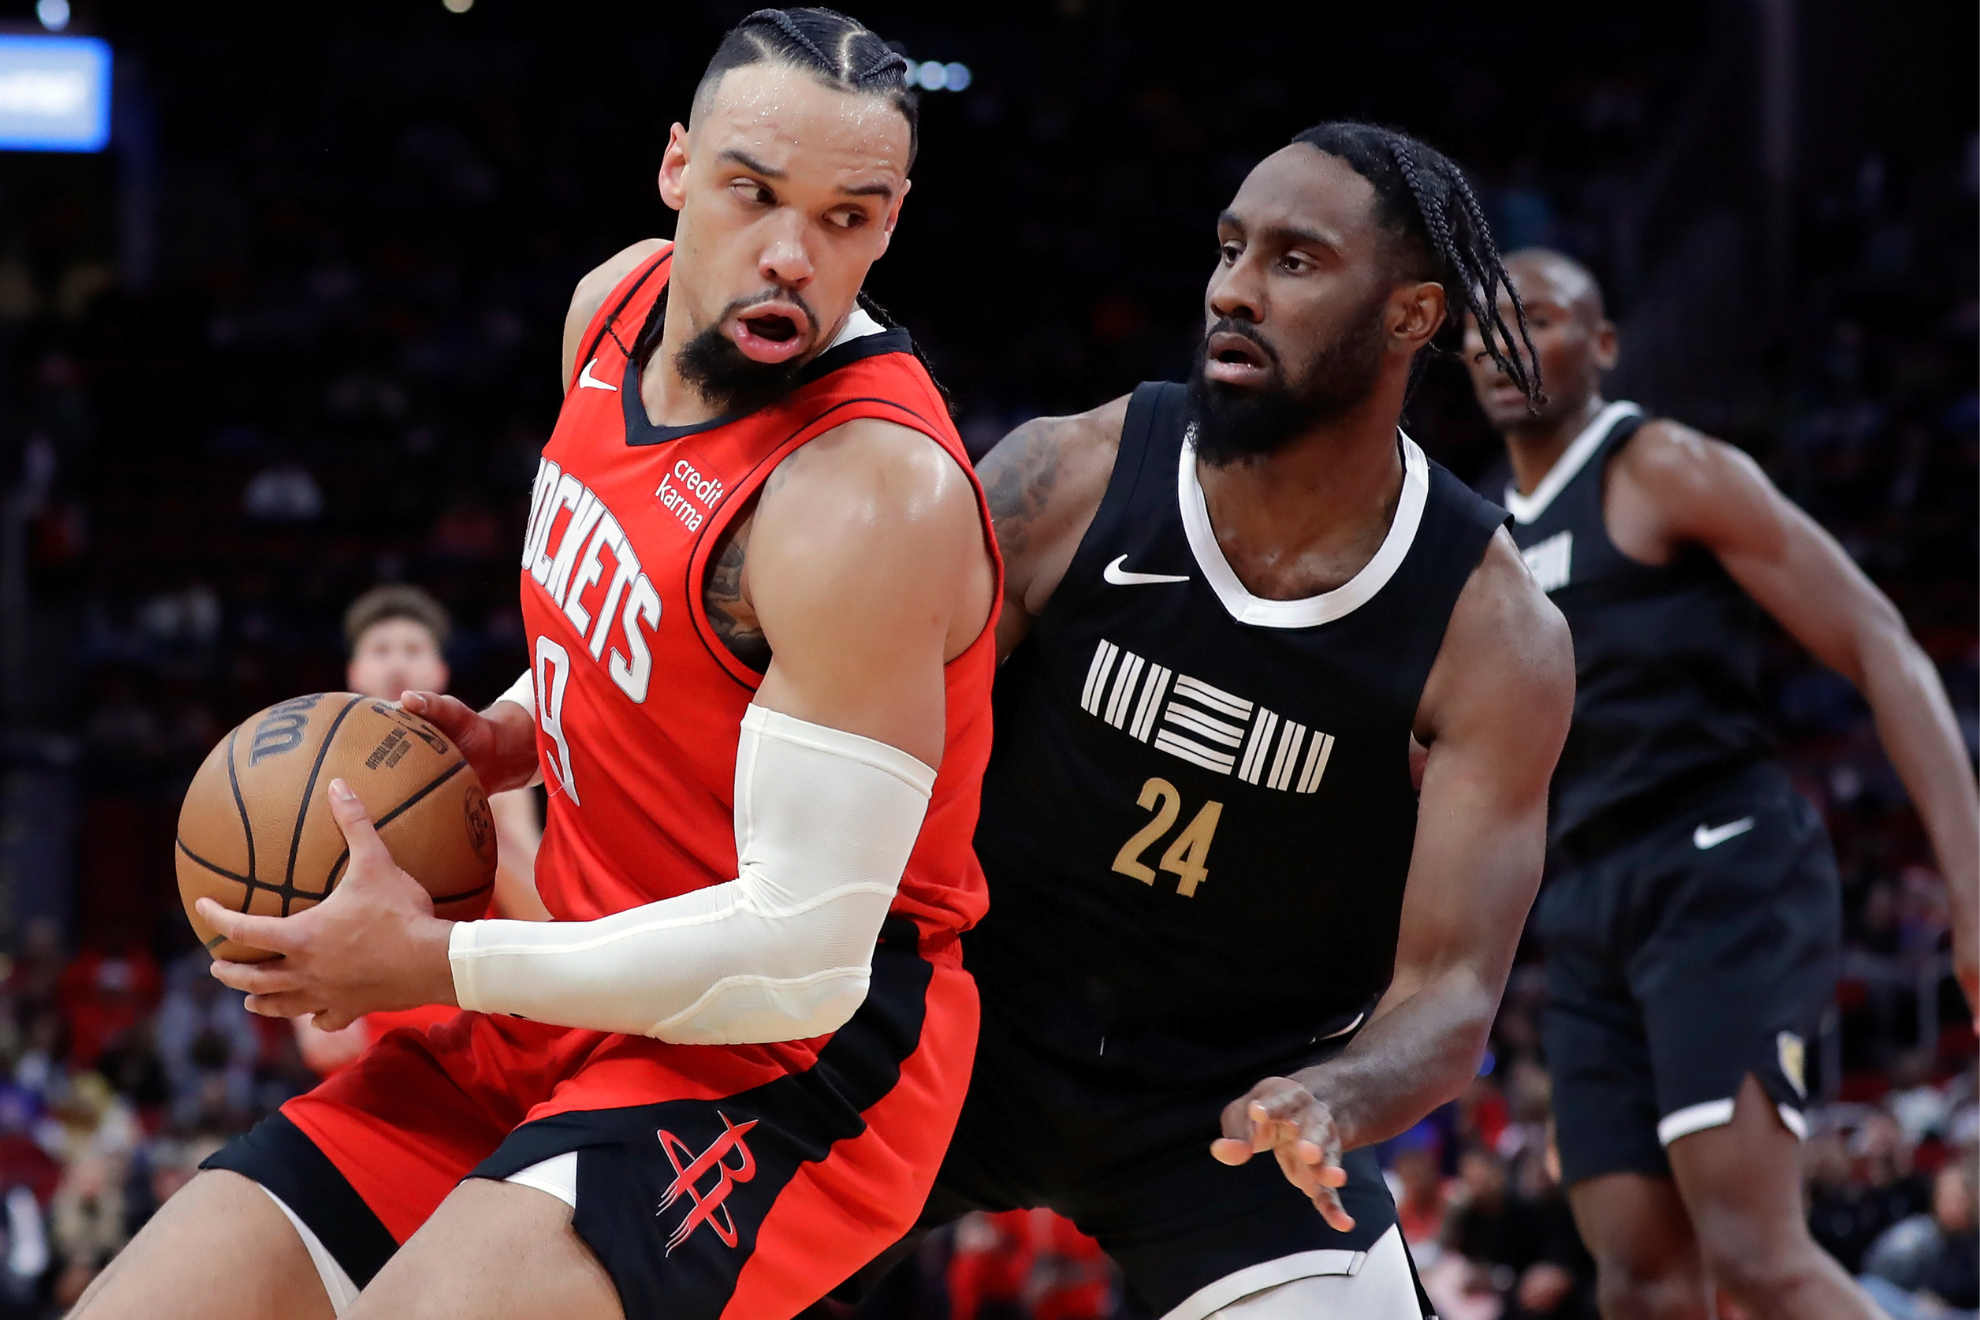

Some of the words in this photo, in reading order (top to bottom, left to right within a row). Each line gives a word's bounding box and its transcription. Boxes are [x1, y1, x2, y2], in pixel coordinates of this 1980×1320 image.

[655, 472, 703, 533] karma
[674, 459, 724, 510] credit
[521, 456, 663, 704] OCKETS
[535, 635, 581, 807] 9
[1111, 777, 1223, 898] 24
